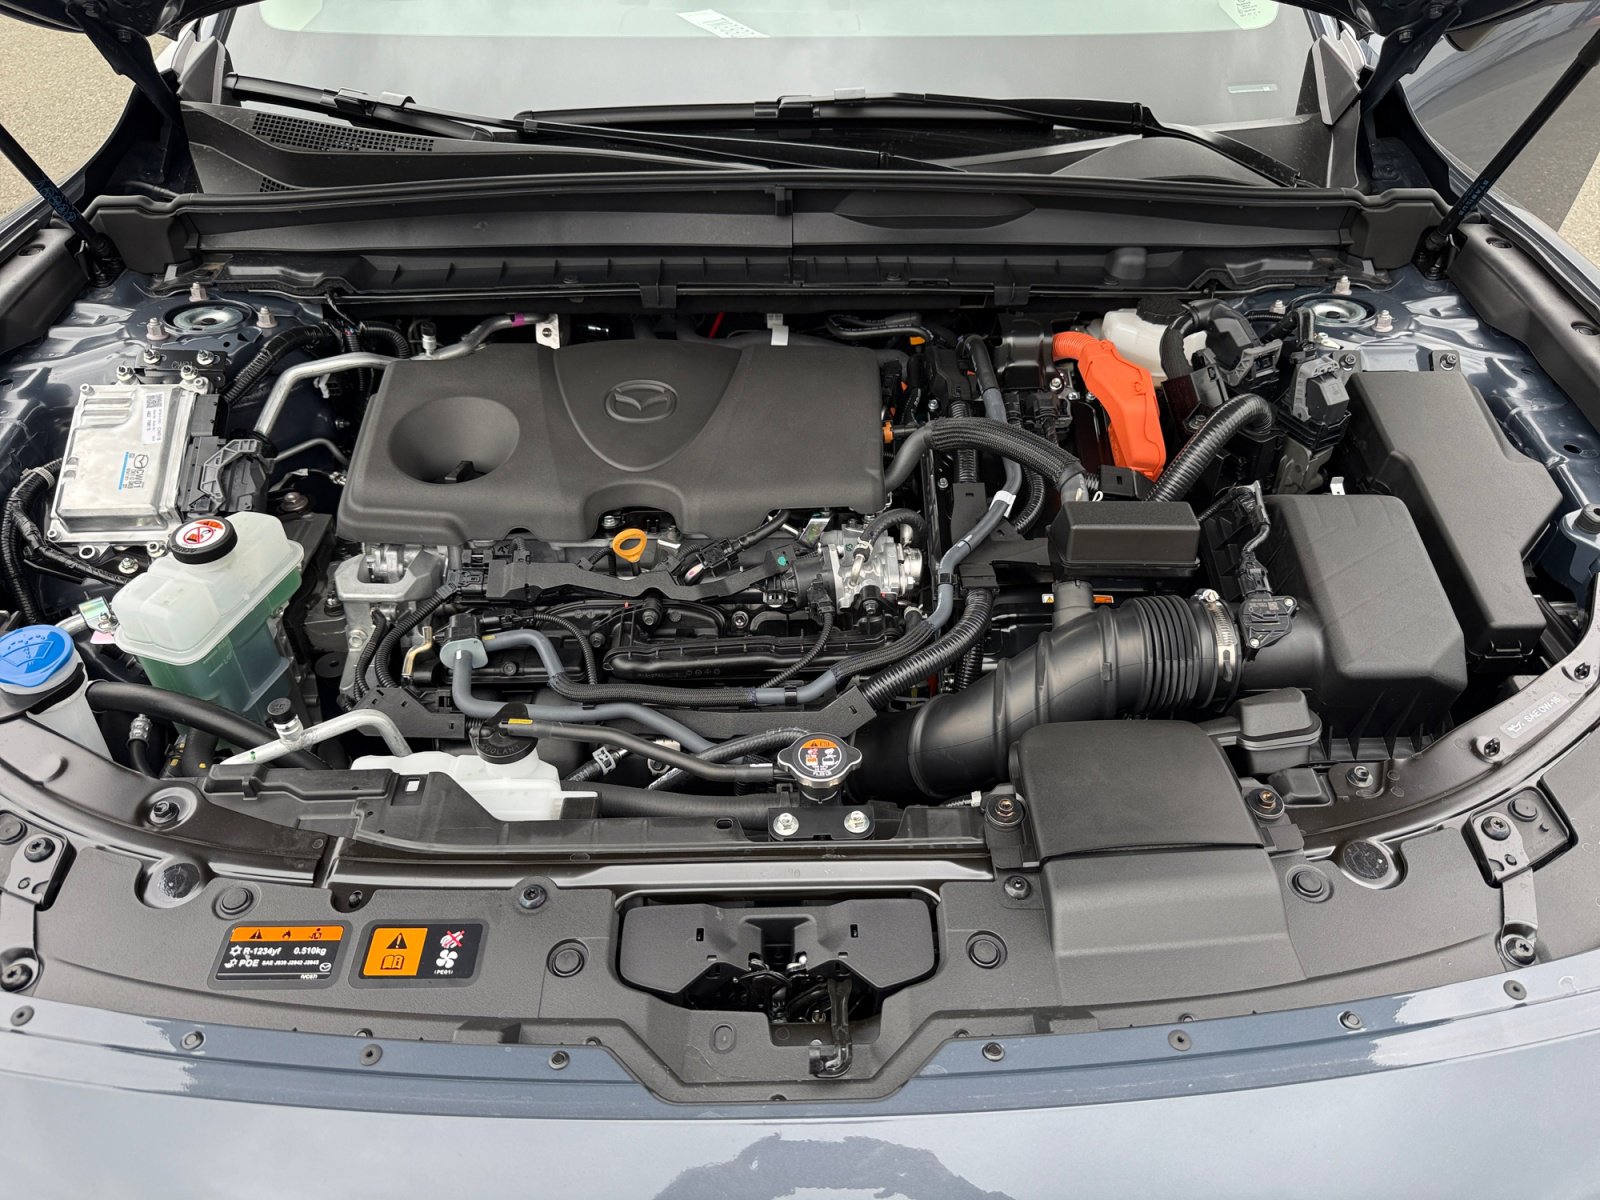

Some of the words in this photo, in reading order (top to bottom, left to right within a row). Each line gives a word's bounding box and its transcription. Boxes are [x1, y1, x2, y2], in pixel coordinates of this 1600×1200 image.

[1524, 709, 1542, 722] SAE
[243, 947, 282, 957] R-1234yf
[293, 947, 327, 957] 0.510kg
[238, 959, 260, 967] POE
